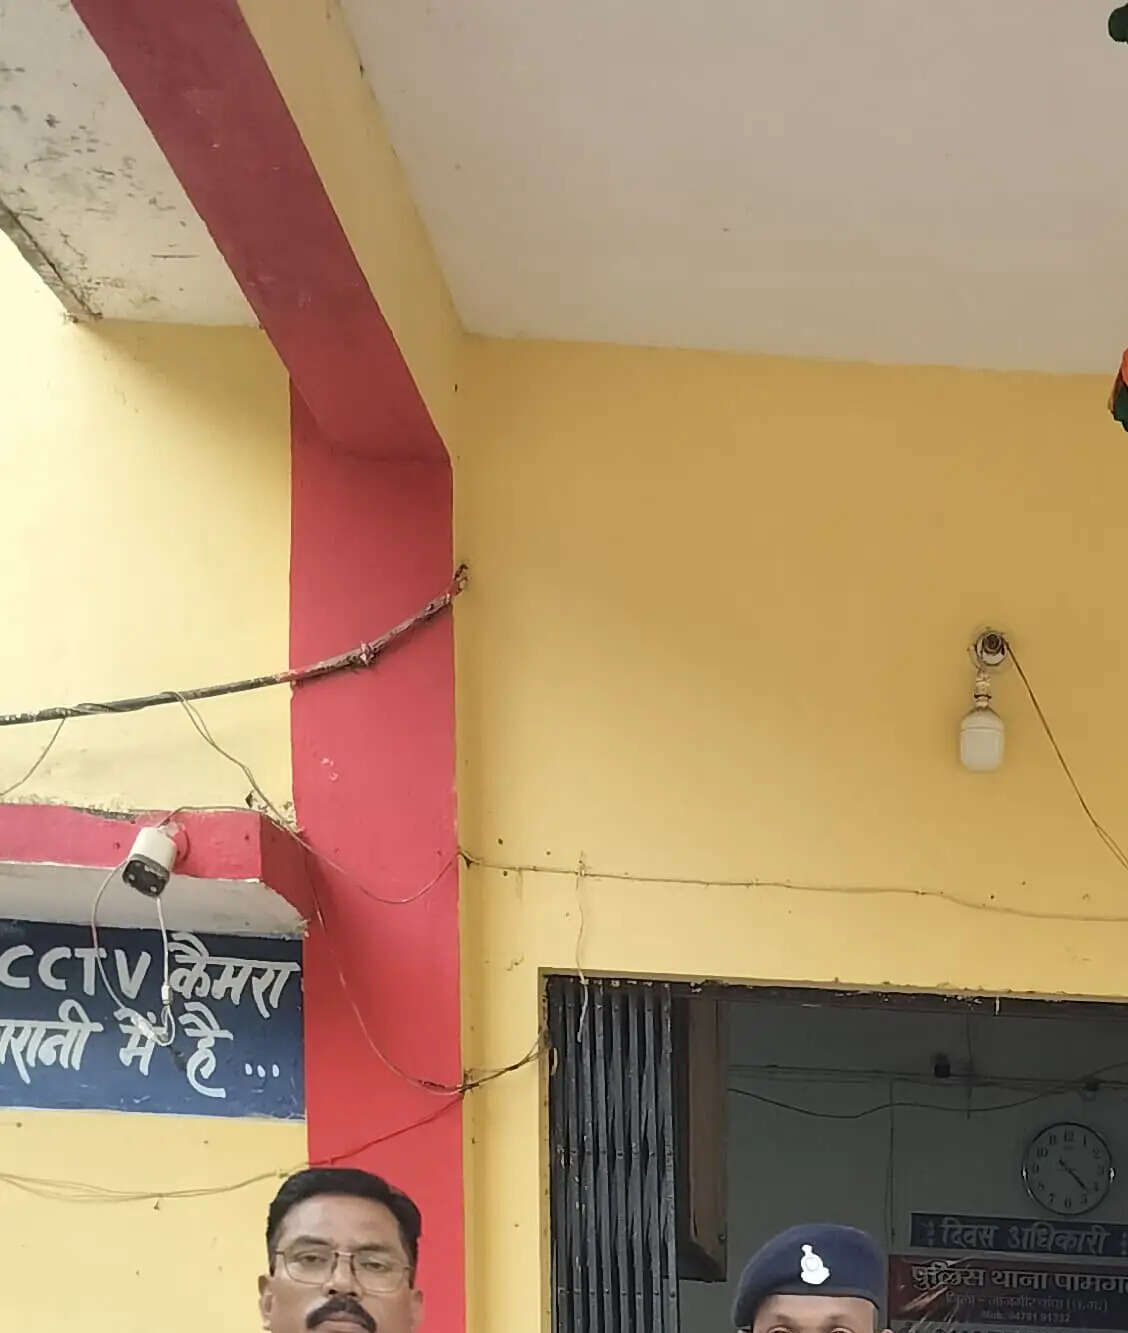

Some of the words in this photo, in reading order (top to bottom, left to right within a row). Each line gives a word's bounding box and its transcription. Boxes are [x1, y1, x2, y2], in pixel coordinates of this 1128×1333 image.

[0, 944, 151, 999] CCTV
[168, 931, 302, 1018] कैमरा
[178, 1002, 234, 1098] है
[940, 1217, 999, 1249] दिवस
[1008, 1221, 1112, 1254] अधिकारी
[991, 1269, 1048, 1291] थाना
